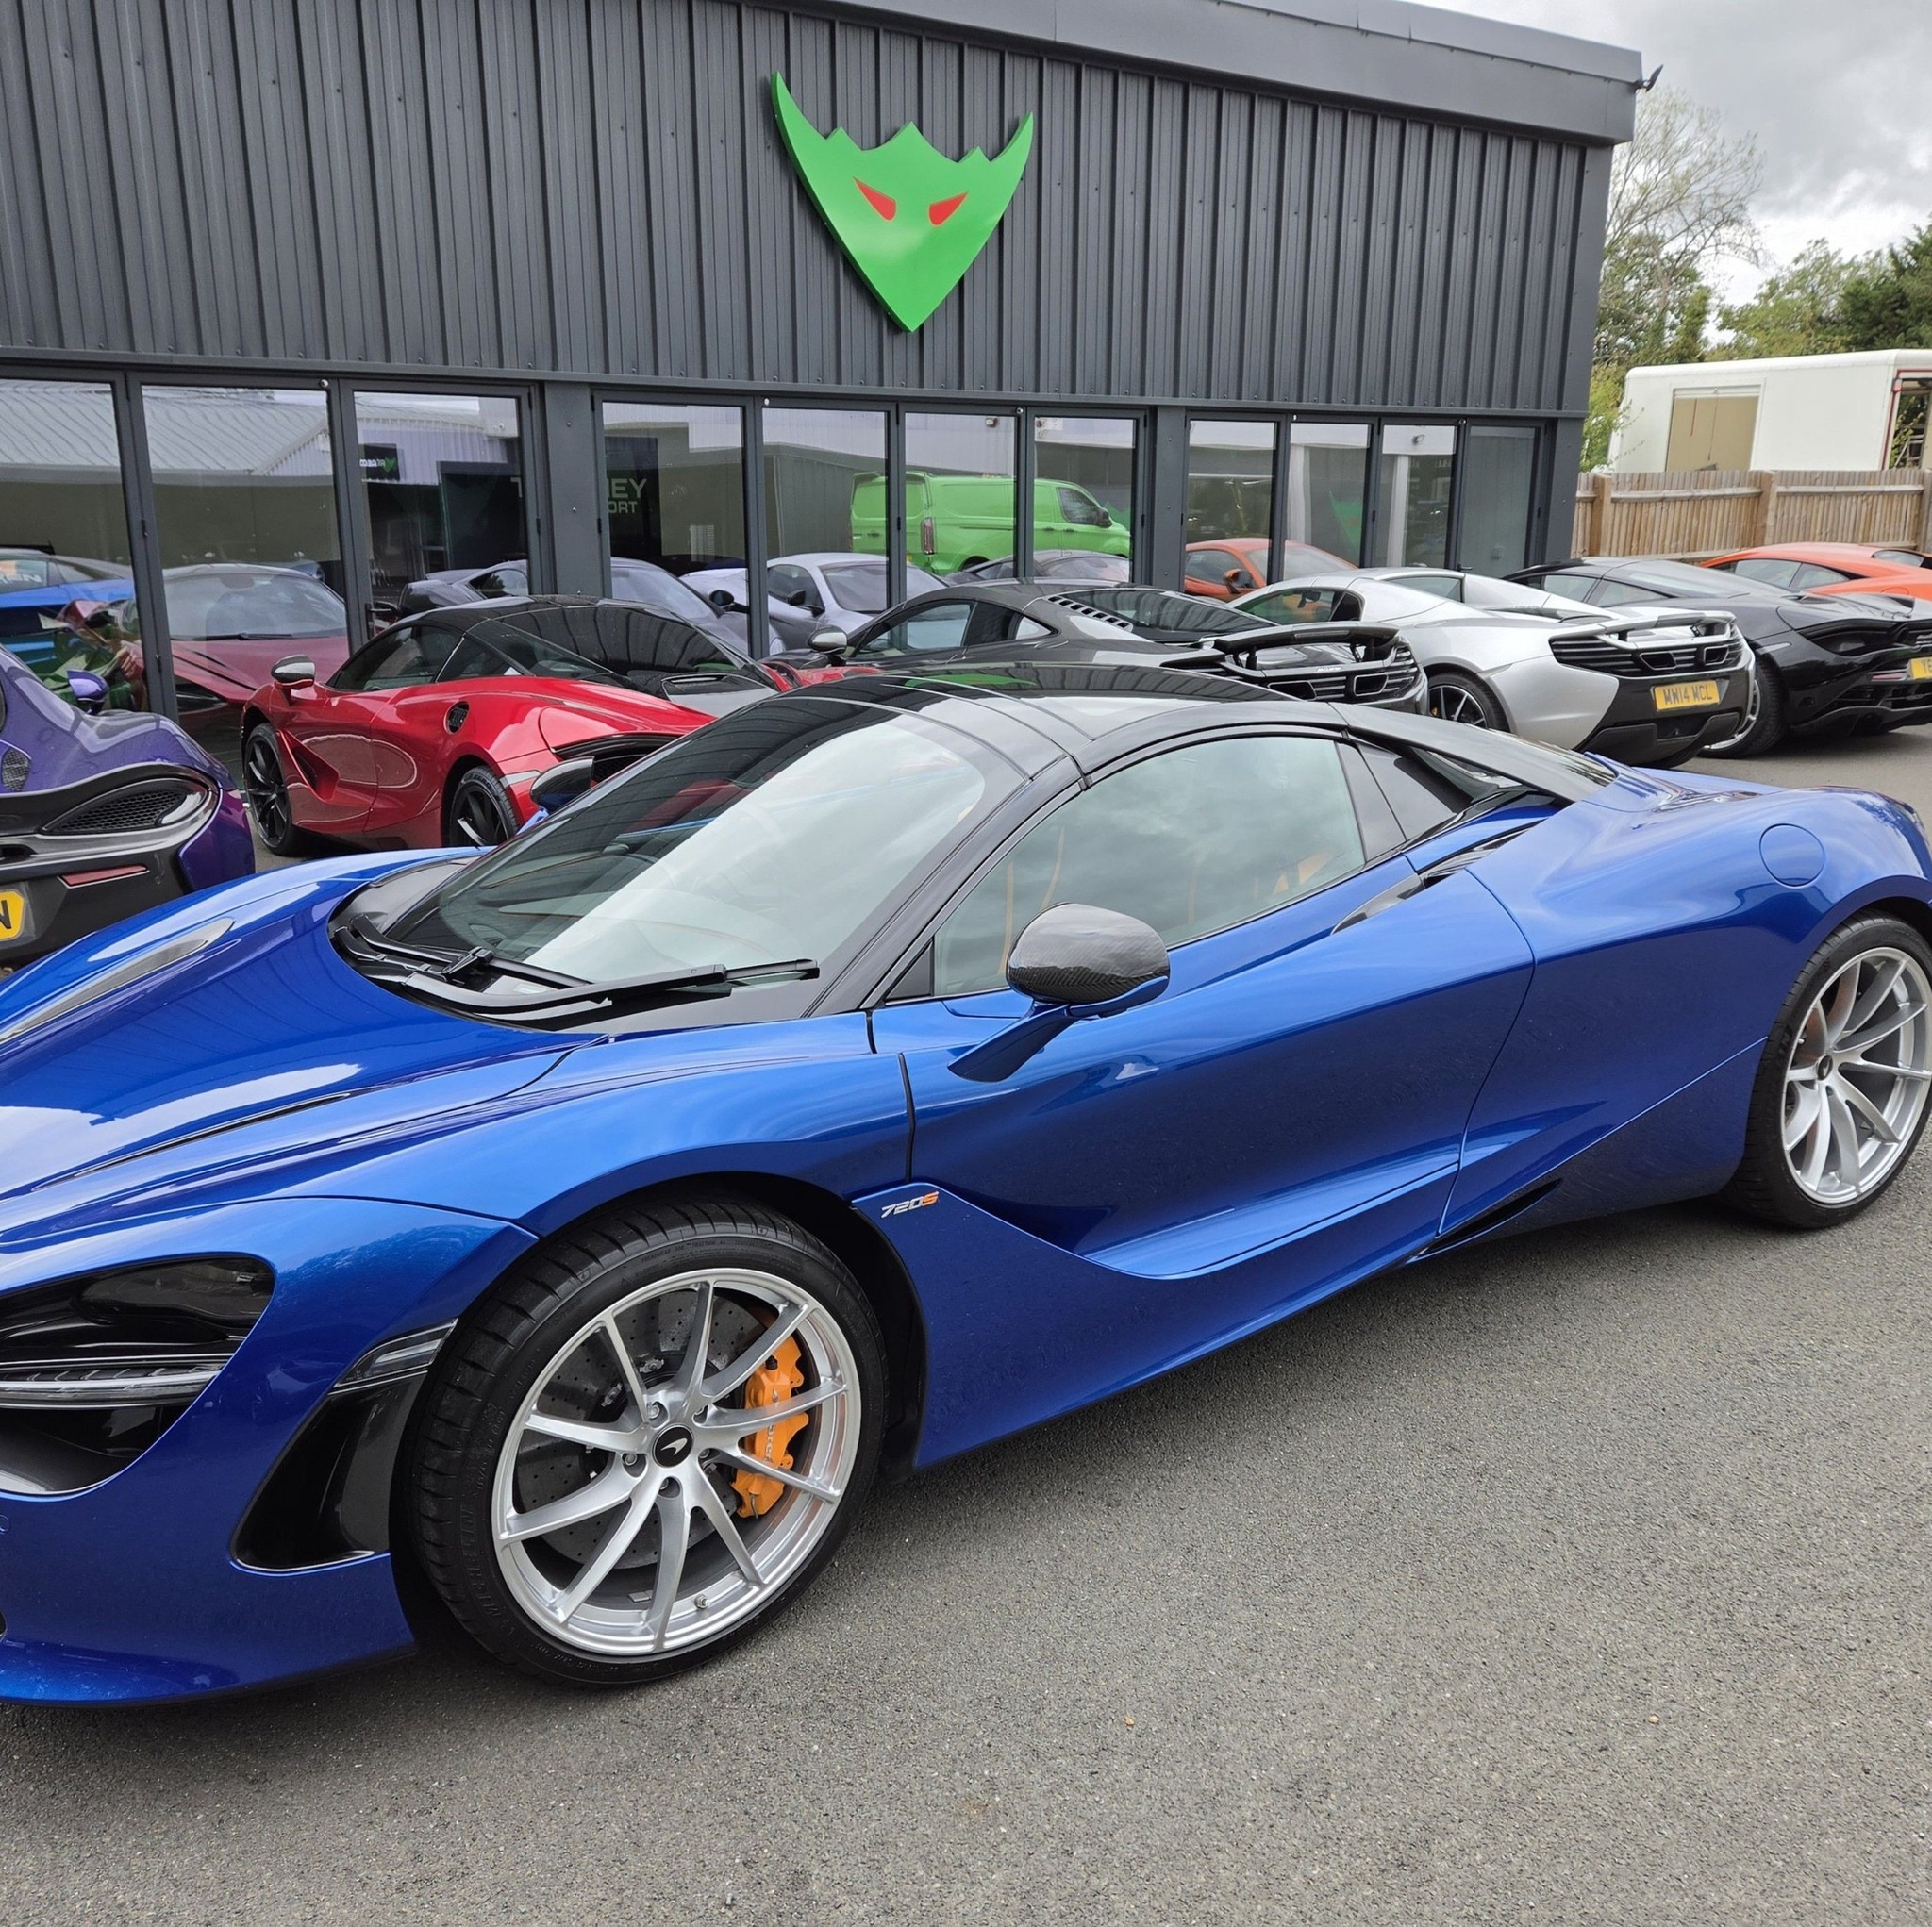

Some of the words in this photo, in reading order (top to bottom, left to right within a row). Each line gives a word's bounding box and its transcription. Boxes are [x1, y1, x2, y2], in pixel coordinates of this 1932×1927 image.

[607, 477, 648, 499] EY
[1663, 687, 1690, 706] MW14
[1691, 684, 1713, 703] MCL
[880, 1190, 940, 1219] 720S
